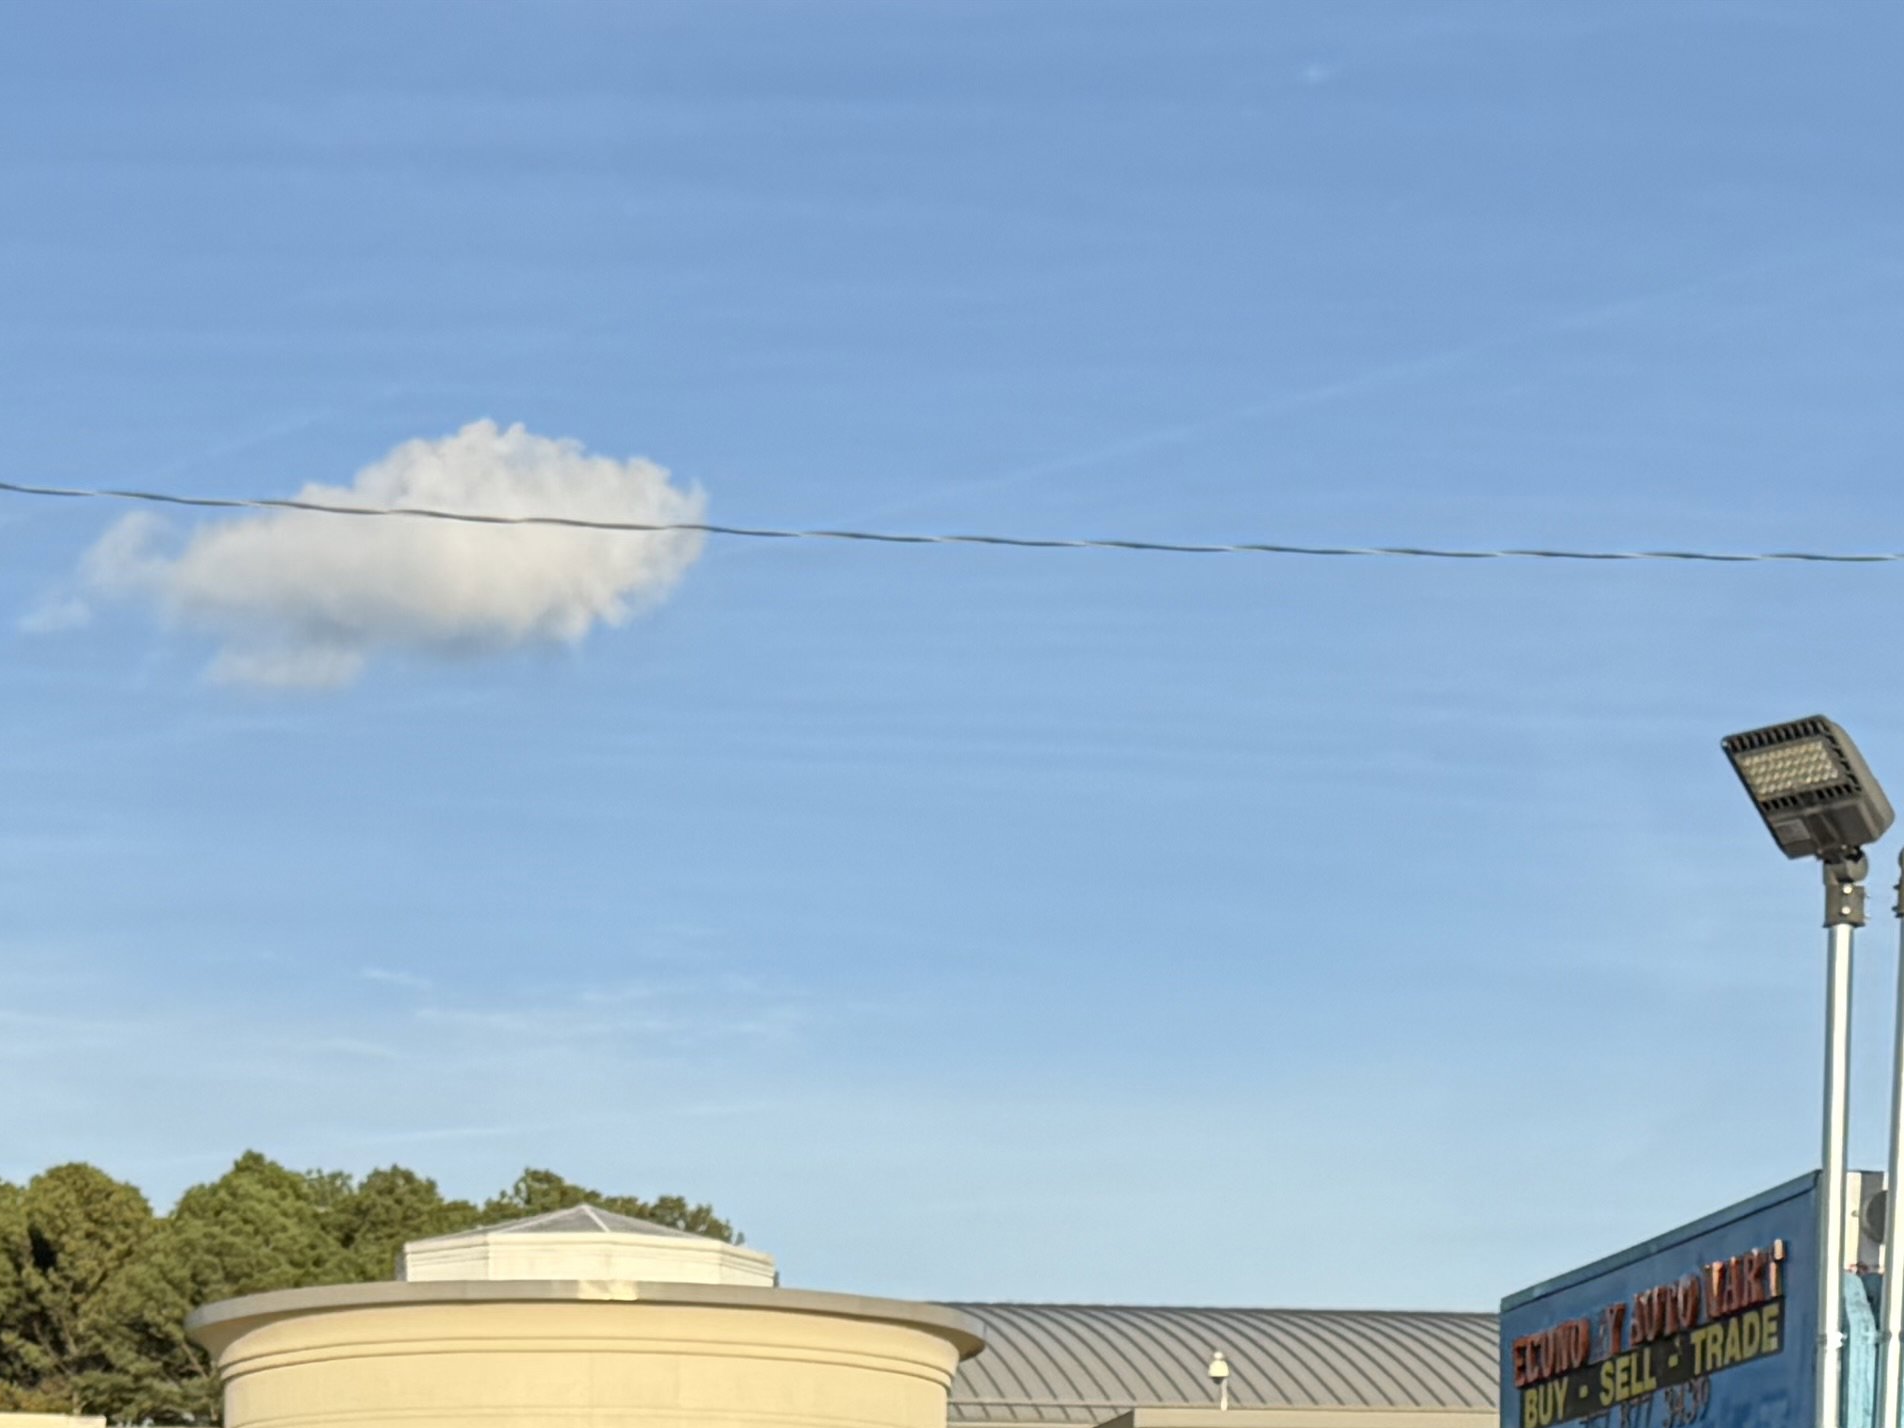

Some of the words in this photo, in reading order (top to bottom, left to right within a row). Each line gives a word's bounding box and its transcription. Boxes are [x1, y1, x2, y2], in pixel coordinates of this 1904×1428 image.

[1512, 1302, 1626, 1388] ECONOY
[1599, 1347, 1657, 1407] SELL
[1690, 1303, 1780, 1376] TRADE
